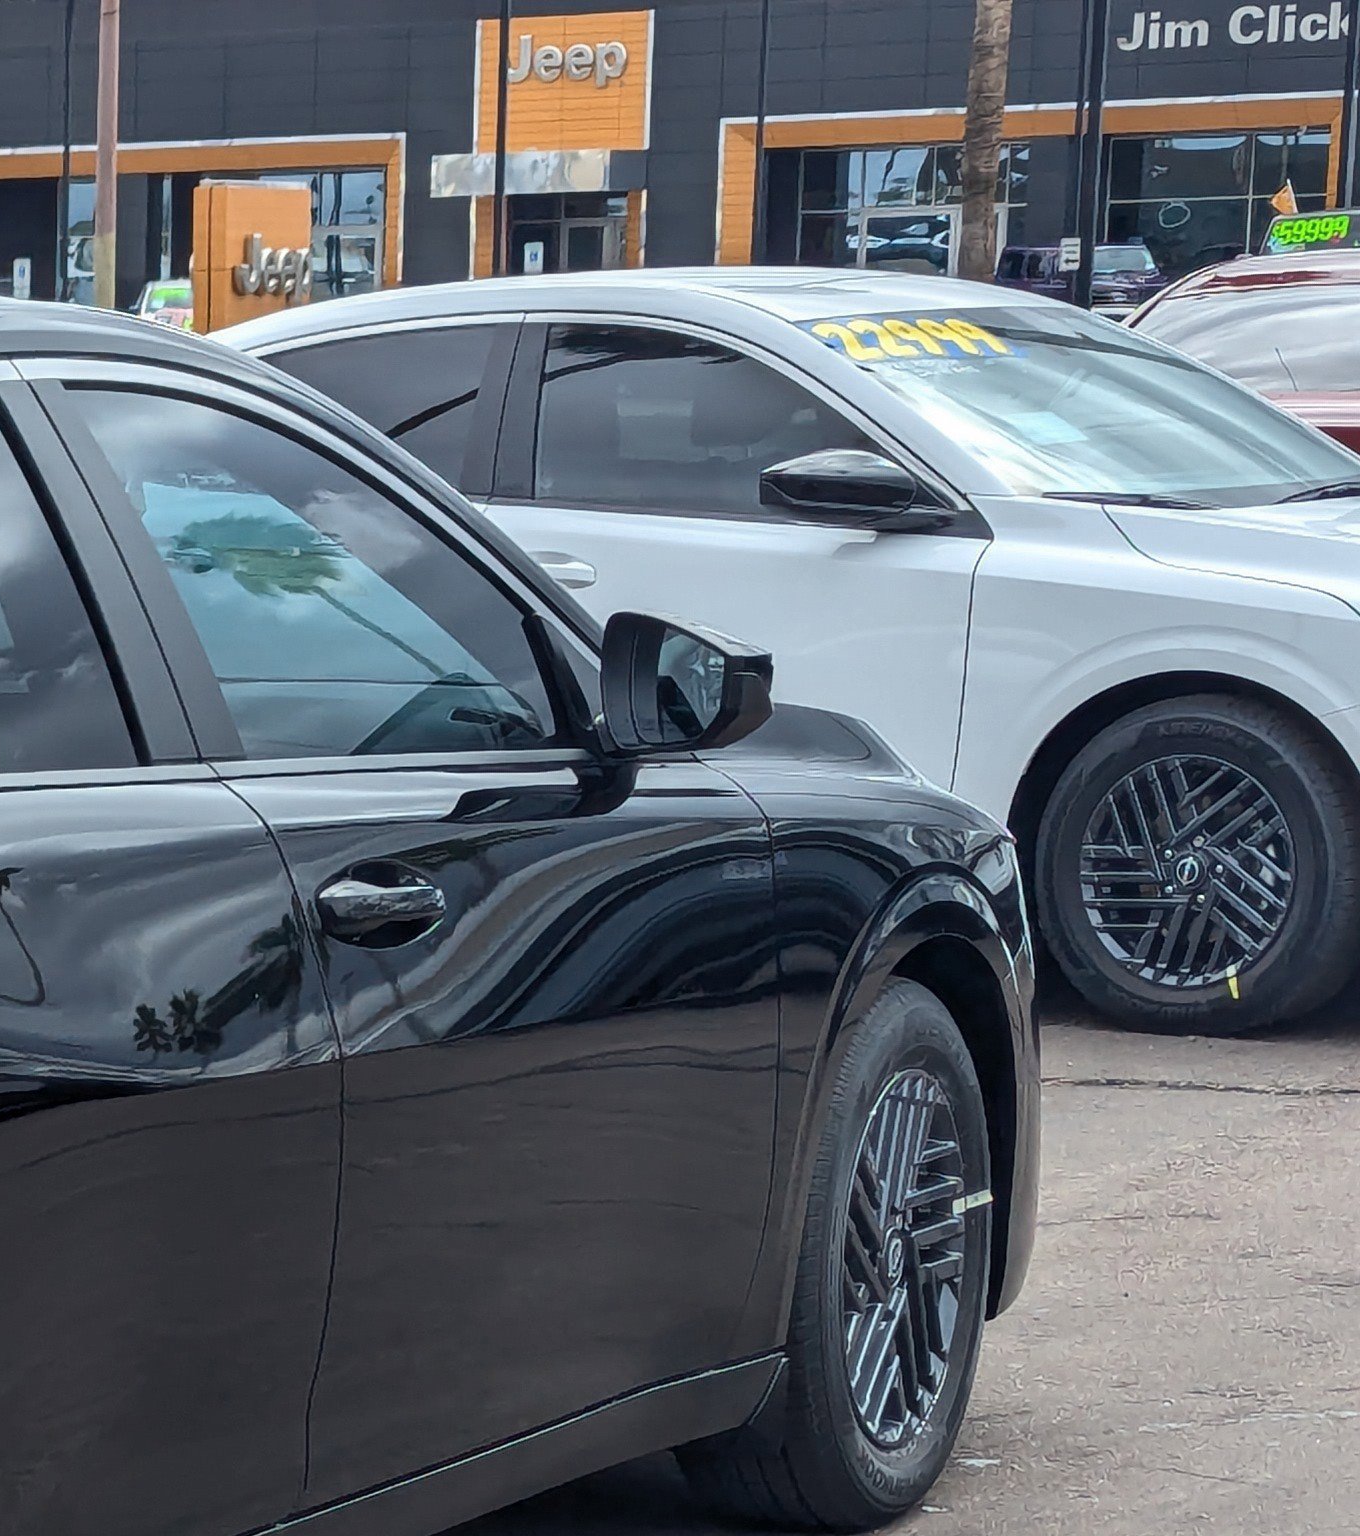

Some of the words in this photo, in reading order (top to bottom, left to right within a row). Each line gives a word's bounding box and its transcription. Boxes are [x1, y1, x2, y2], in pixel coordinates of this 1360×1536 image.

[1116, 11, 1209, 51] Jim
[1229, 1, 1349, 45] Click
[507, 34, 627, 88] Jeep
[233, 232, 313, 306] Jeep
